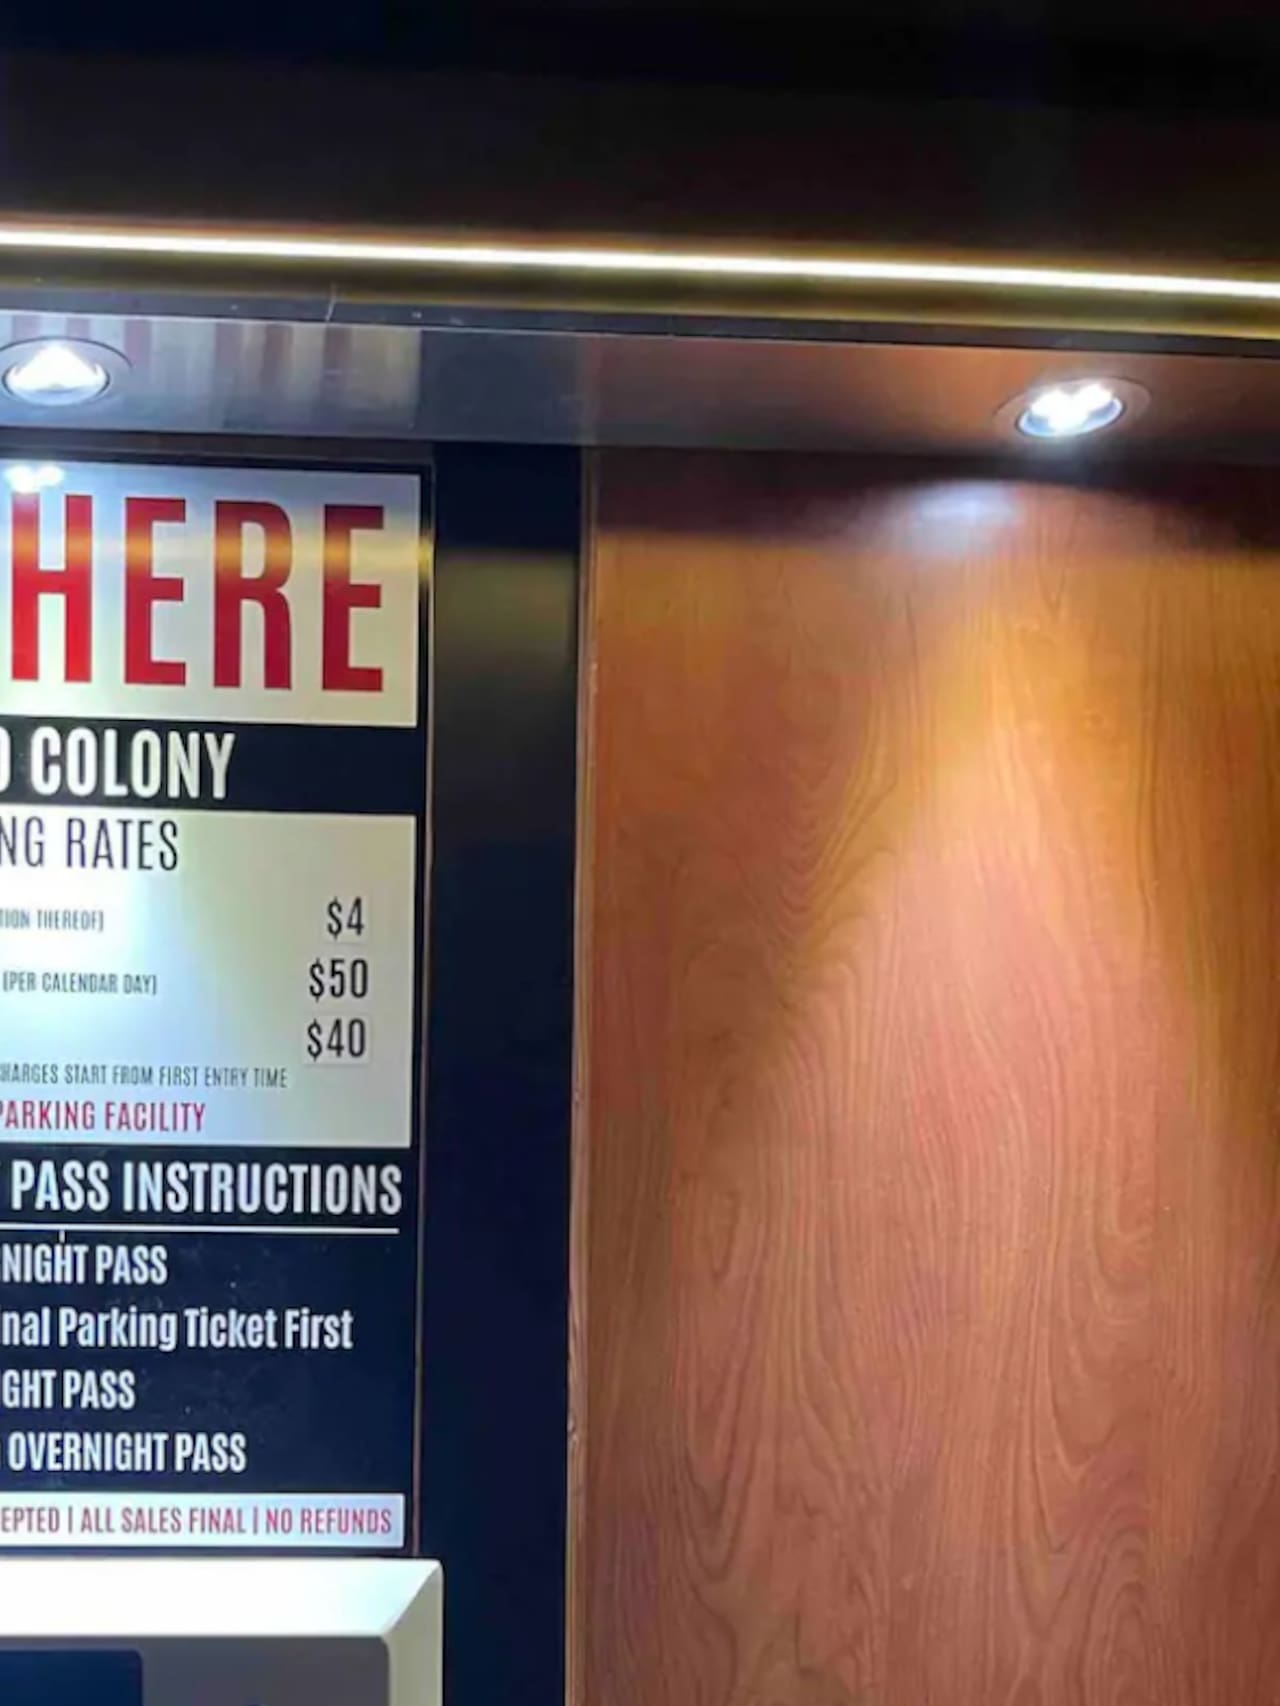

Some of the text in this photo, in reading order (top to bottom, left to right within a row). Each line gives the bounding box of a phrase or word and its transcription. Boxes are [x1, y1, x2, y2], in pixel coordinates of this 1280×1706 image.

[10, 491, 385, 692] HERE
[30, 729, 236, 799] COLONY
[65, 818, 179, 873] RATES
[327, 897, 364, 940] $4
[42, 972, 118, 994] CALENDAR
[309, 957, 368, 1003] $50
[307, 1018, 365, 1062] $40
[65, 1064, 107, 1085] START
[113, 1065, 152, 1086] FROM
[159, 1066, 199, 1087] FIRST
[204, 1067, 249, 1088] ENTRY
[253, 1068, 288, 1088] TIME
[105, 1101, 206, 1132] FACILITY
[12, 1160, 110, 1212] PASS
[122, 1161, 402, 1215] INSTRUCTIONS
[95, 1245, 168, 1285] PASS
[58, 1306, 177, 1351] Parking
[184, 1307, 277, 1348] Ticket
[284, 1308, 353, 1349] First
[62, 1369, 136, 1410] PASS
[7, 1431, 169, 1472] OVERNIGHT
[174, 1433, 247, 1473] PASS
[80, 1507, 115, 1534] ALL
[121, 1507, 182, 1534] SALES
[188, 1507, 246, 1534] FINAL
[266, 1508, 293, 1535] NO
[300, 1508, 392, 1535] REFUNDS
